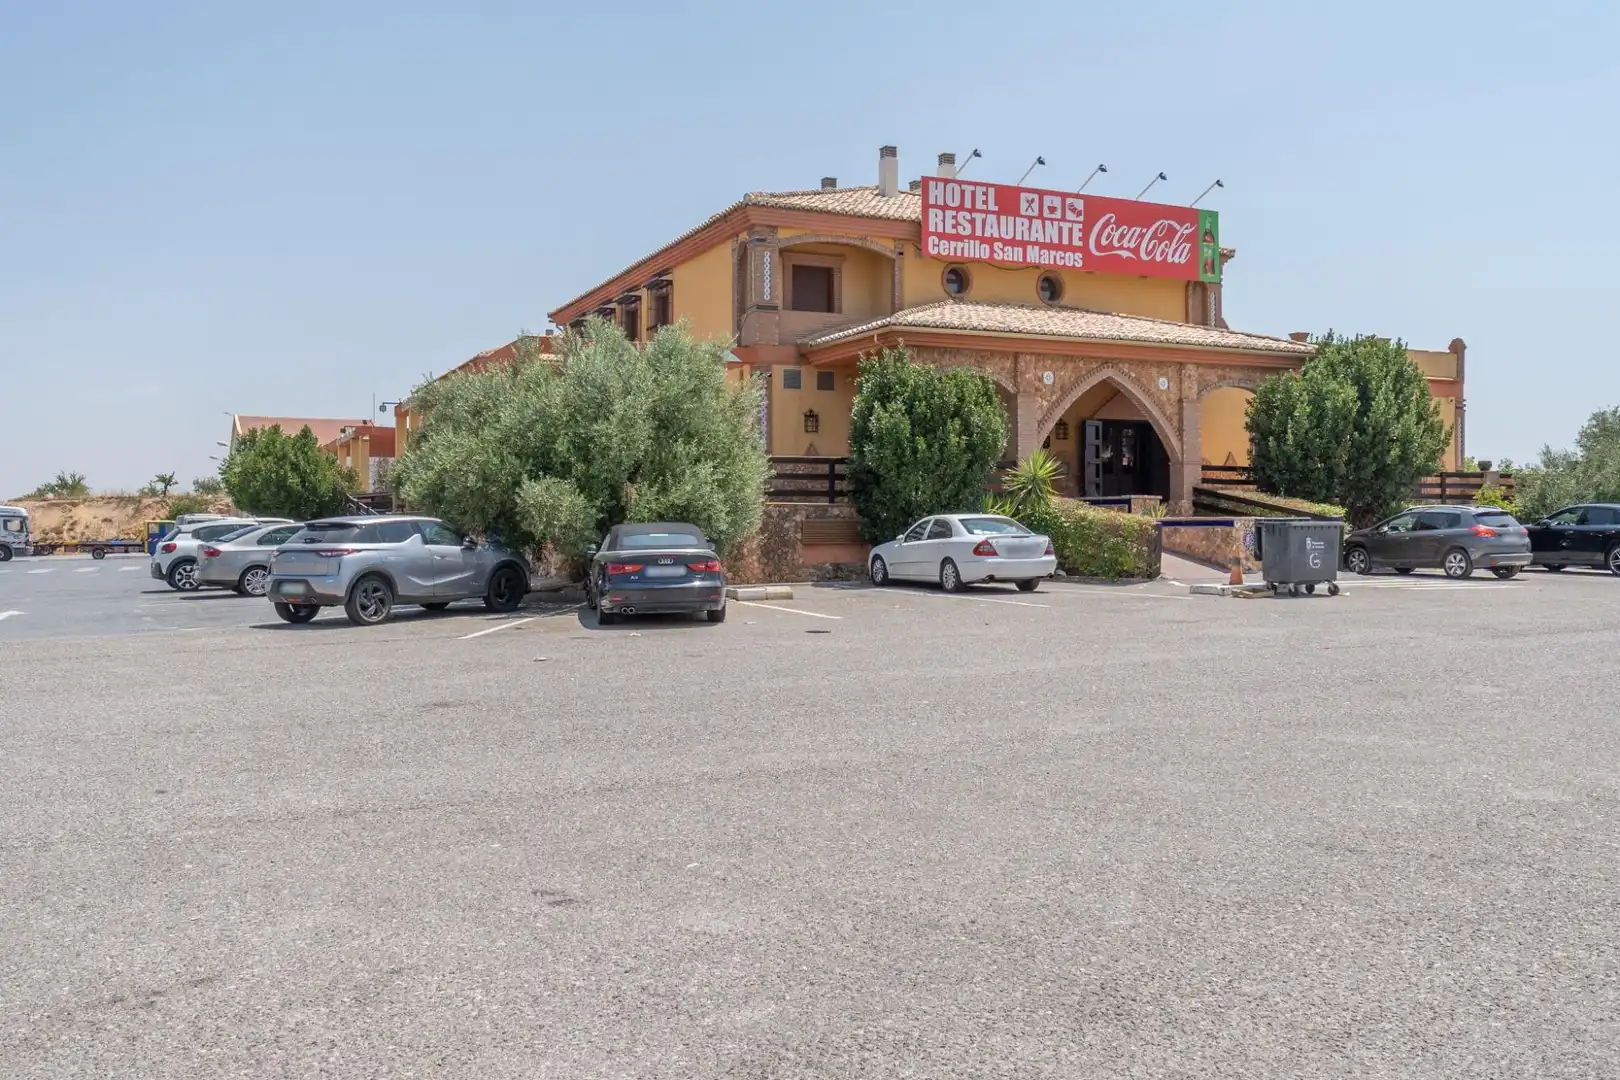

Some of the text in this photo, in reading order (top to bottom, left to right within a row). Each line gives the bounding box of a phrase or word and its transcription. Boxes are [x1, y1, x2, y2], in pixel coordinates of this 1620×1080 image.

[928, 181, 998, 210] HOTEL
[928, 208, 1083, 247] RESTAURANTE
[1089, 213, 1197, 264] Coca-Cola
[928, 236, 1083, 268] Cerrillo San Marcos
